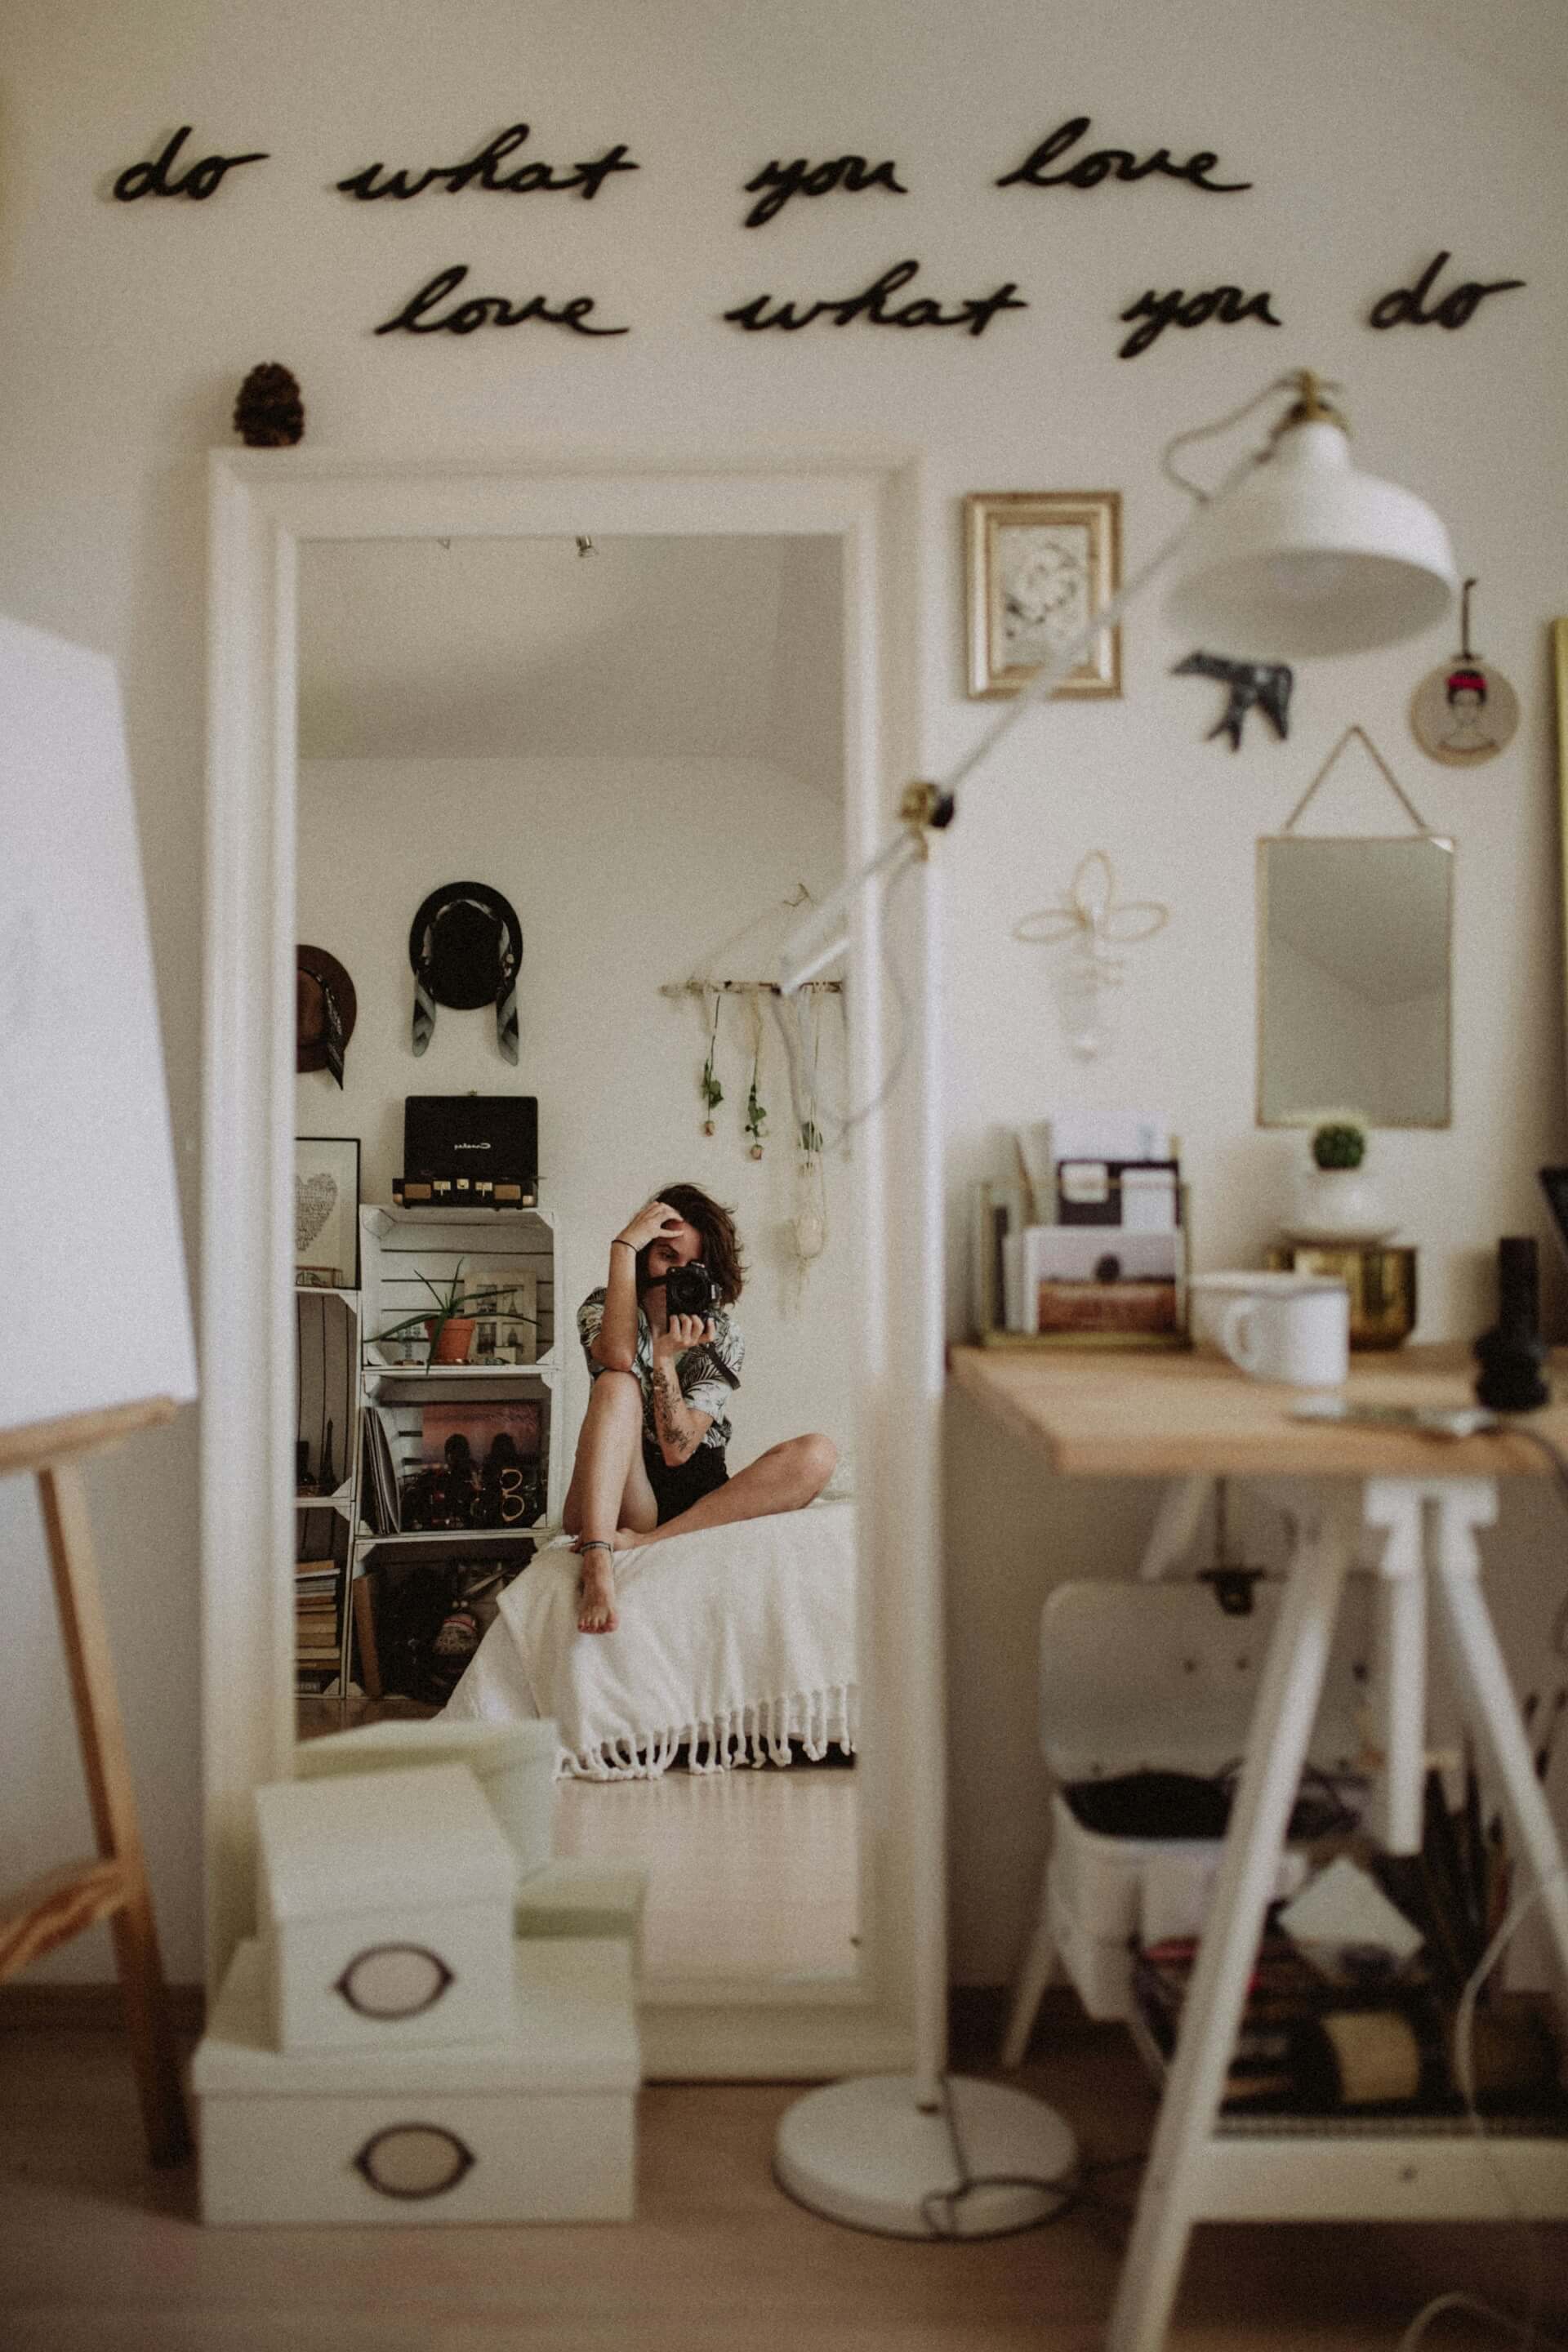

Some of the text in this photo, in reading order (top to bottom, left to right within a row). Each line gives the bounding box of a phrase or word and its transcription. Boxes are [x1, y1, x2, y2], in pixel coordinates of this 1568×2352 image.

[114, 117, 1252, 229] do what you love
[375, 252, 1526, 359] love what you do
